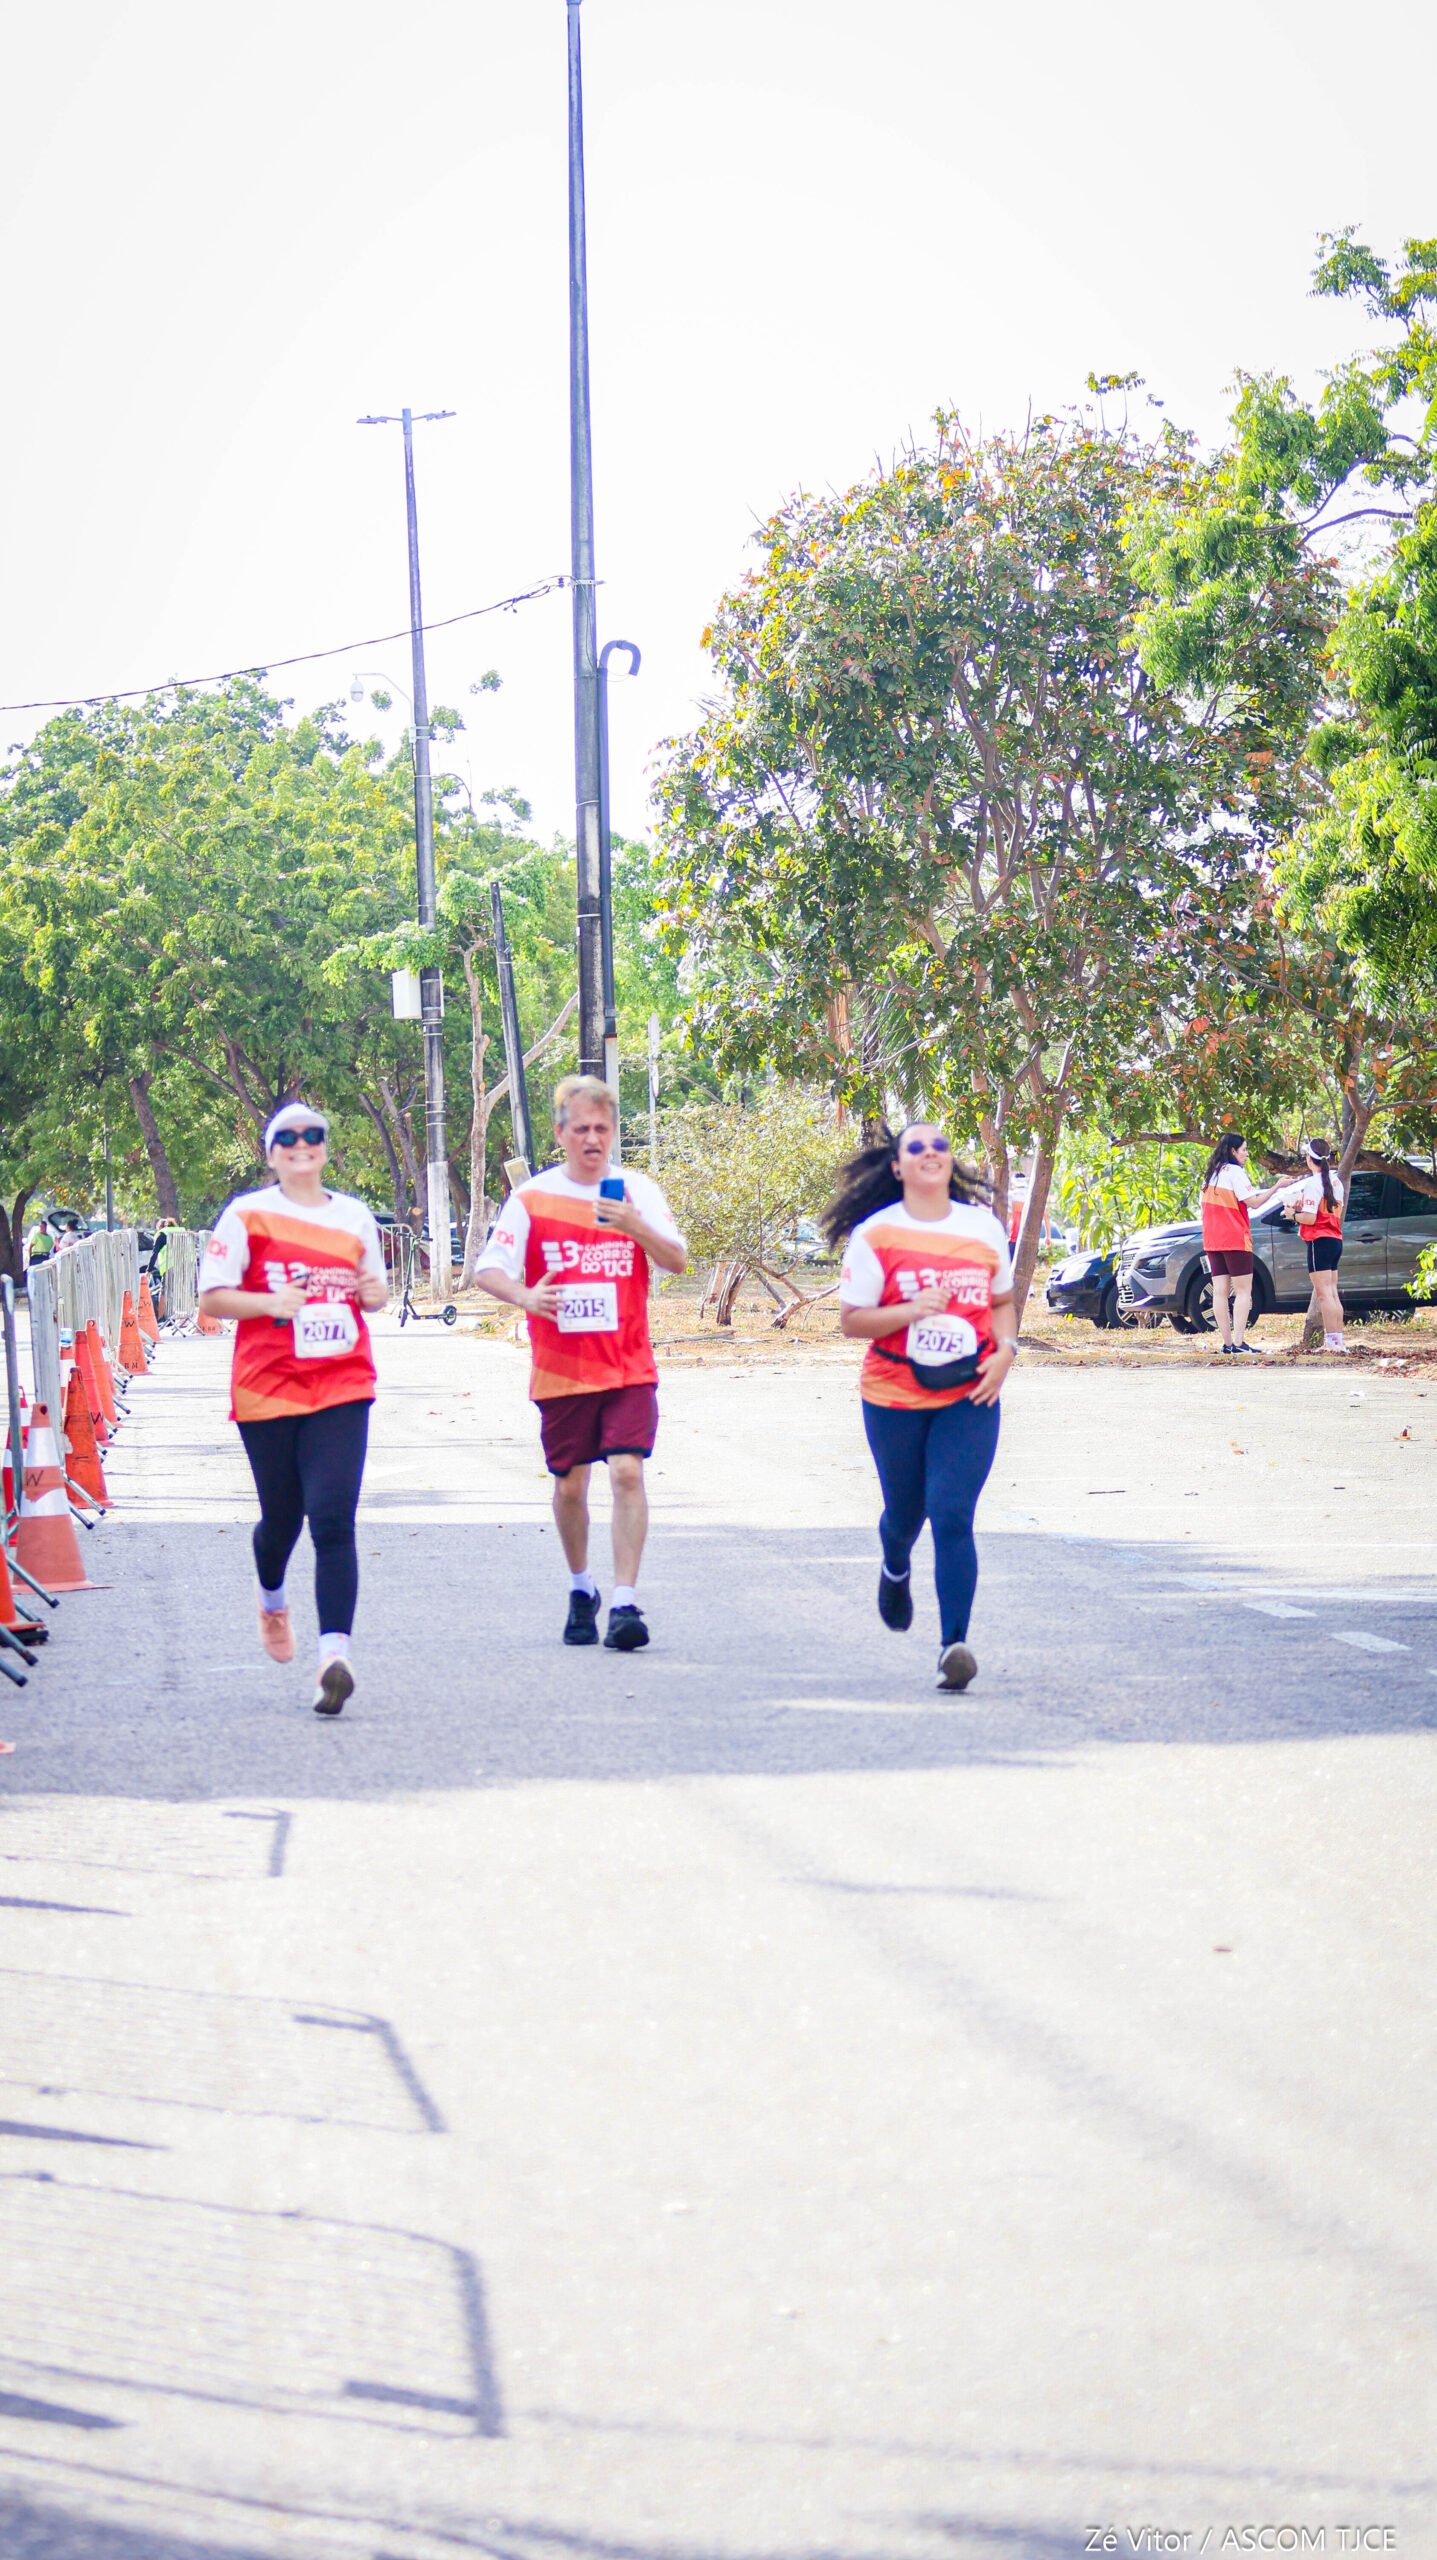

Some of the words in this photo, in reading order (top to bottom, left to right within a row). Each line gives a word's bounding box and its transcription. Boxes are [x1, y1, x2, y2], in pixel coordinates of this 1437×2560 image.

[581, 1261, 601, 1274] DO
[565, 1299, 604, 1318] 2015
[304, 1321, 345, 1342] 2077
[917, 1329, 962, 1354] 2075
